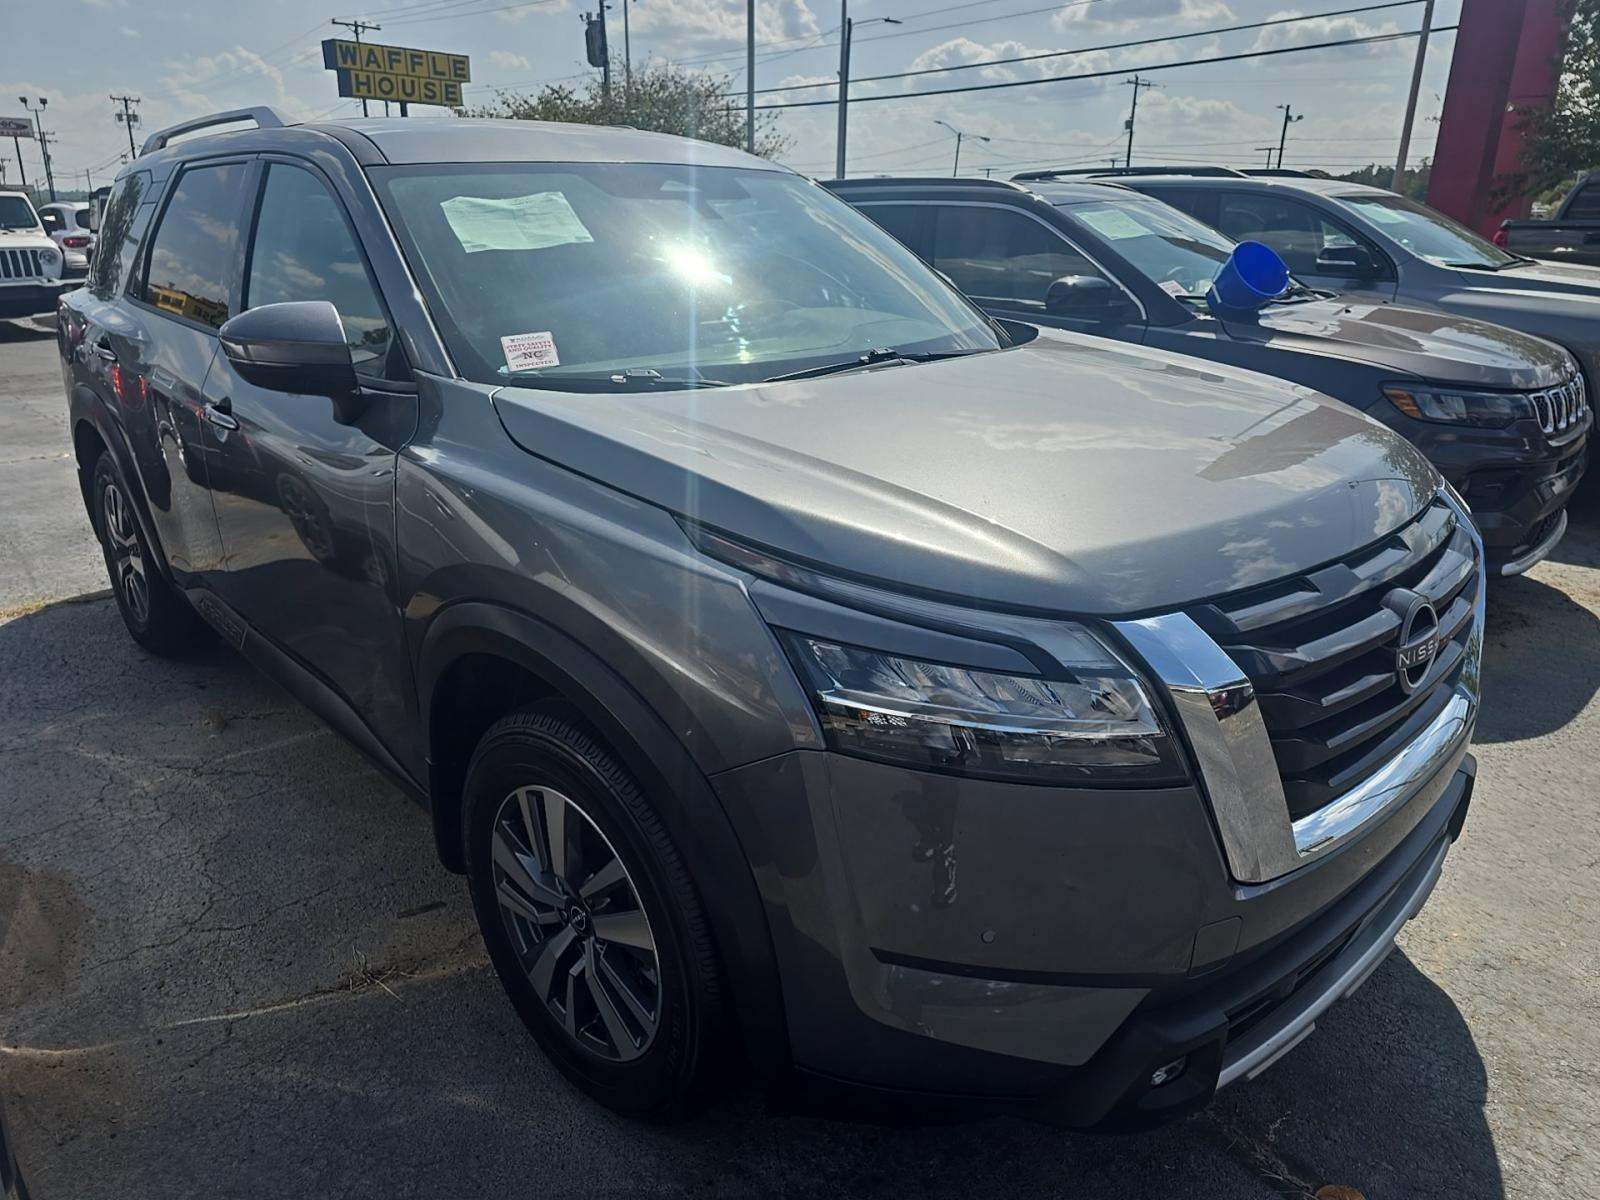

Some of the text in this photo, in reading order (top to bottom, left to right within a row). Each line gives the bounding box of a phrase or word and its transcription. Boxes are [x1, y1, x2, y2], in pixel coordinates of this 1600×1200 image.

[338, 44, 467, 79] WAFFLE
[354, 73, 458, 102] HOUSE
[522, 350, 543, 360] NC
[1399, 639, 1439, 667] NISS
